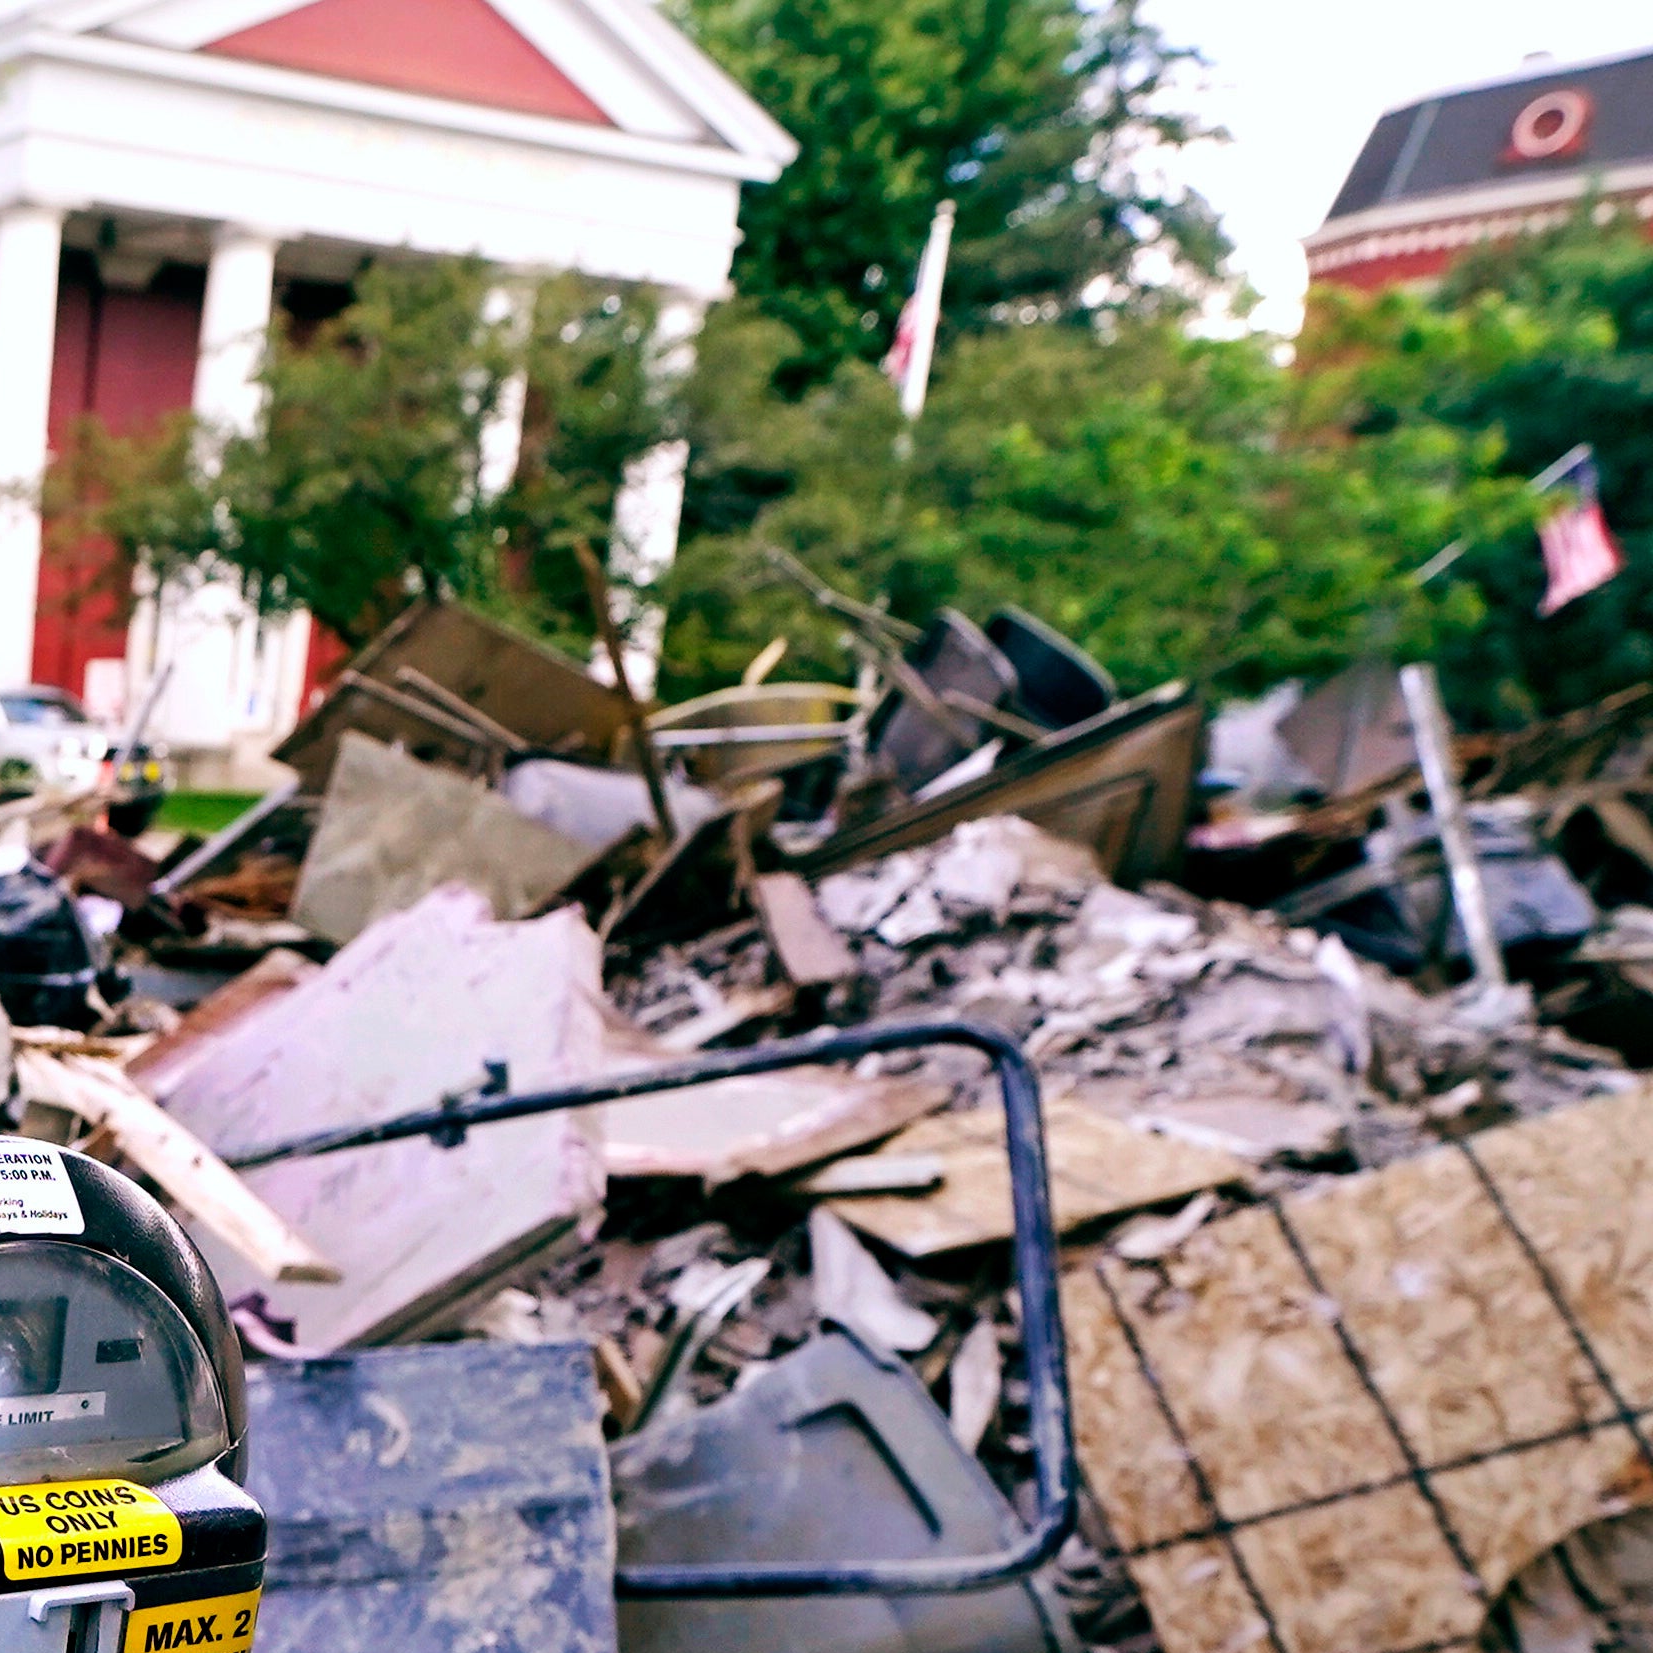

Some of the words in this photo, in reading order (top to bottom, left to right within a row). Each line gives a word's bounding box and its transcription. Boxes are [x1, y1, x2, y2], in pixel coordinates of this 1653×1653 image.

[1, 1169, 28, 1180] 5:00
[32, 1170, 56, 1181] P.M.
[21, 1211, 28, 1219] &
[30, 1210, 68, 1220] Holidays
[7, 1411, 55, 1426] LIMIT
[45, 1486, 137, 1511] COINS
[46, 1510, 118, 1534] ONLY
[18, 1546, 54, 1570] NO
[60, 1533, 168, 1565] PENNIES
[144, 1615, 223, 1653] MAX.
[233, 1609, 251, 1637] 2
